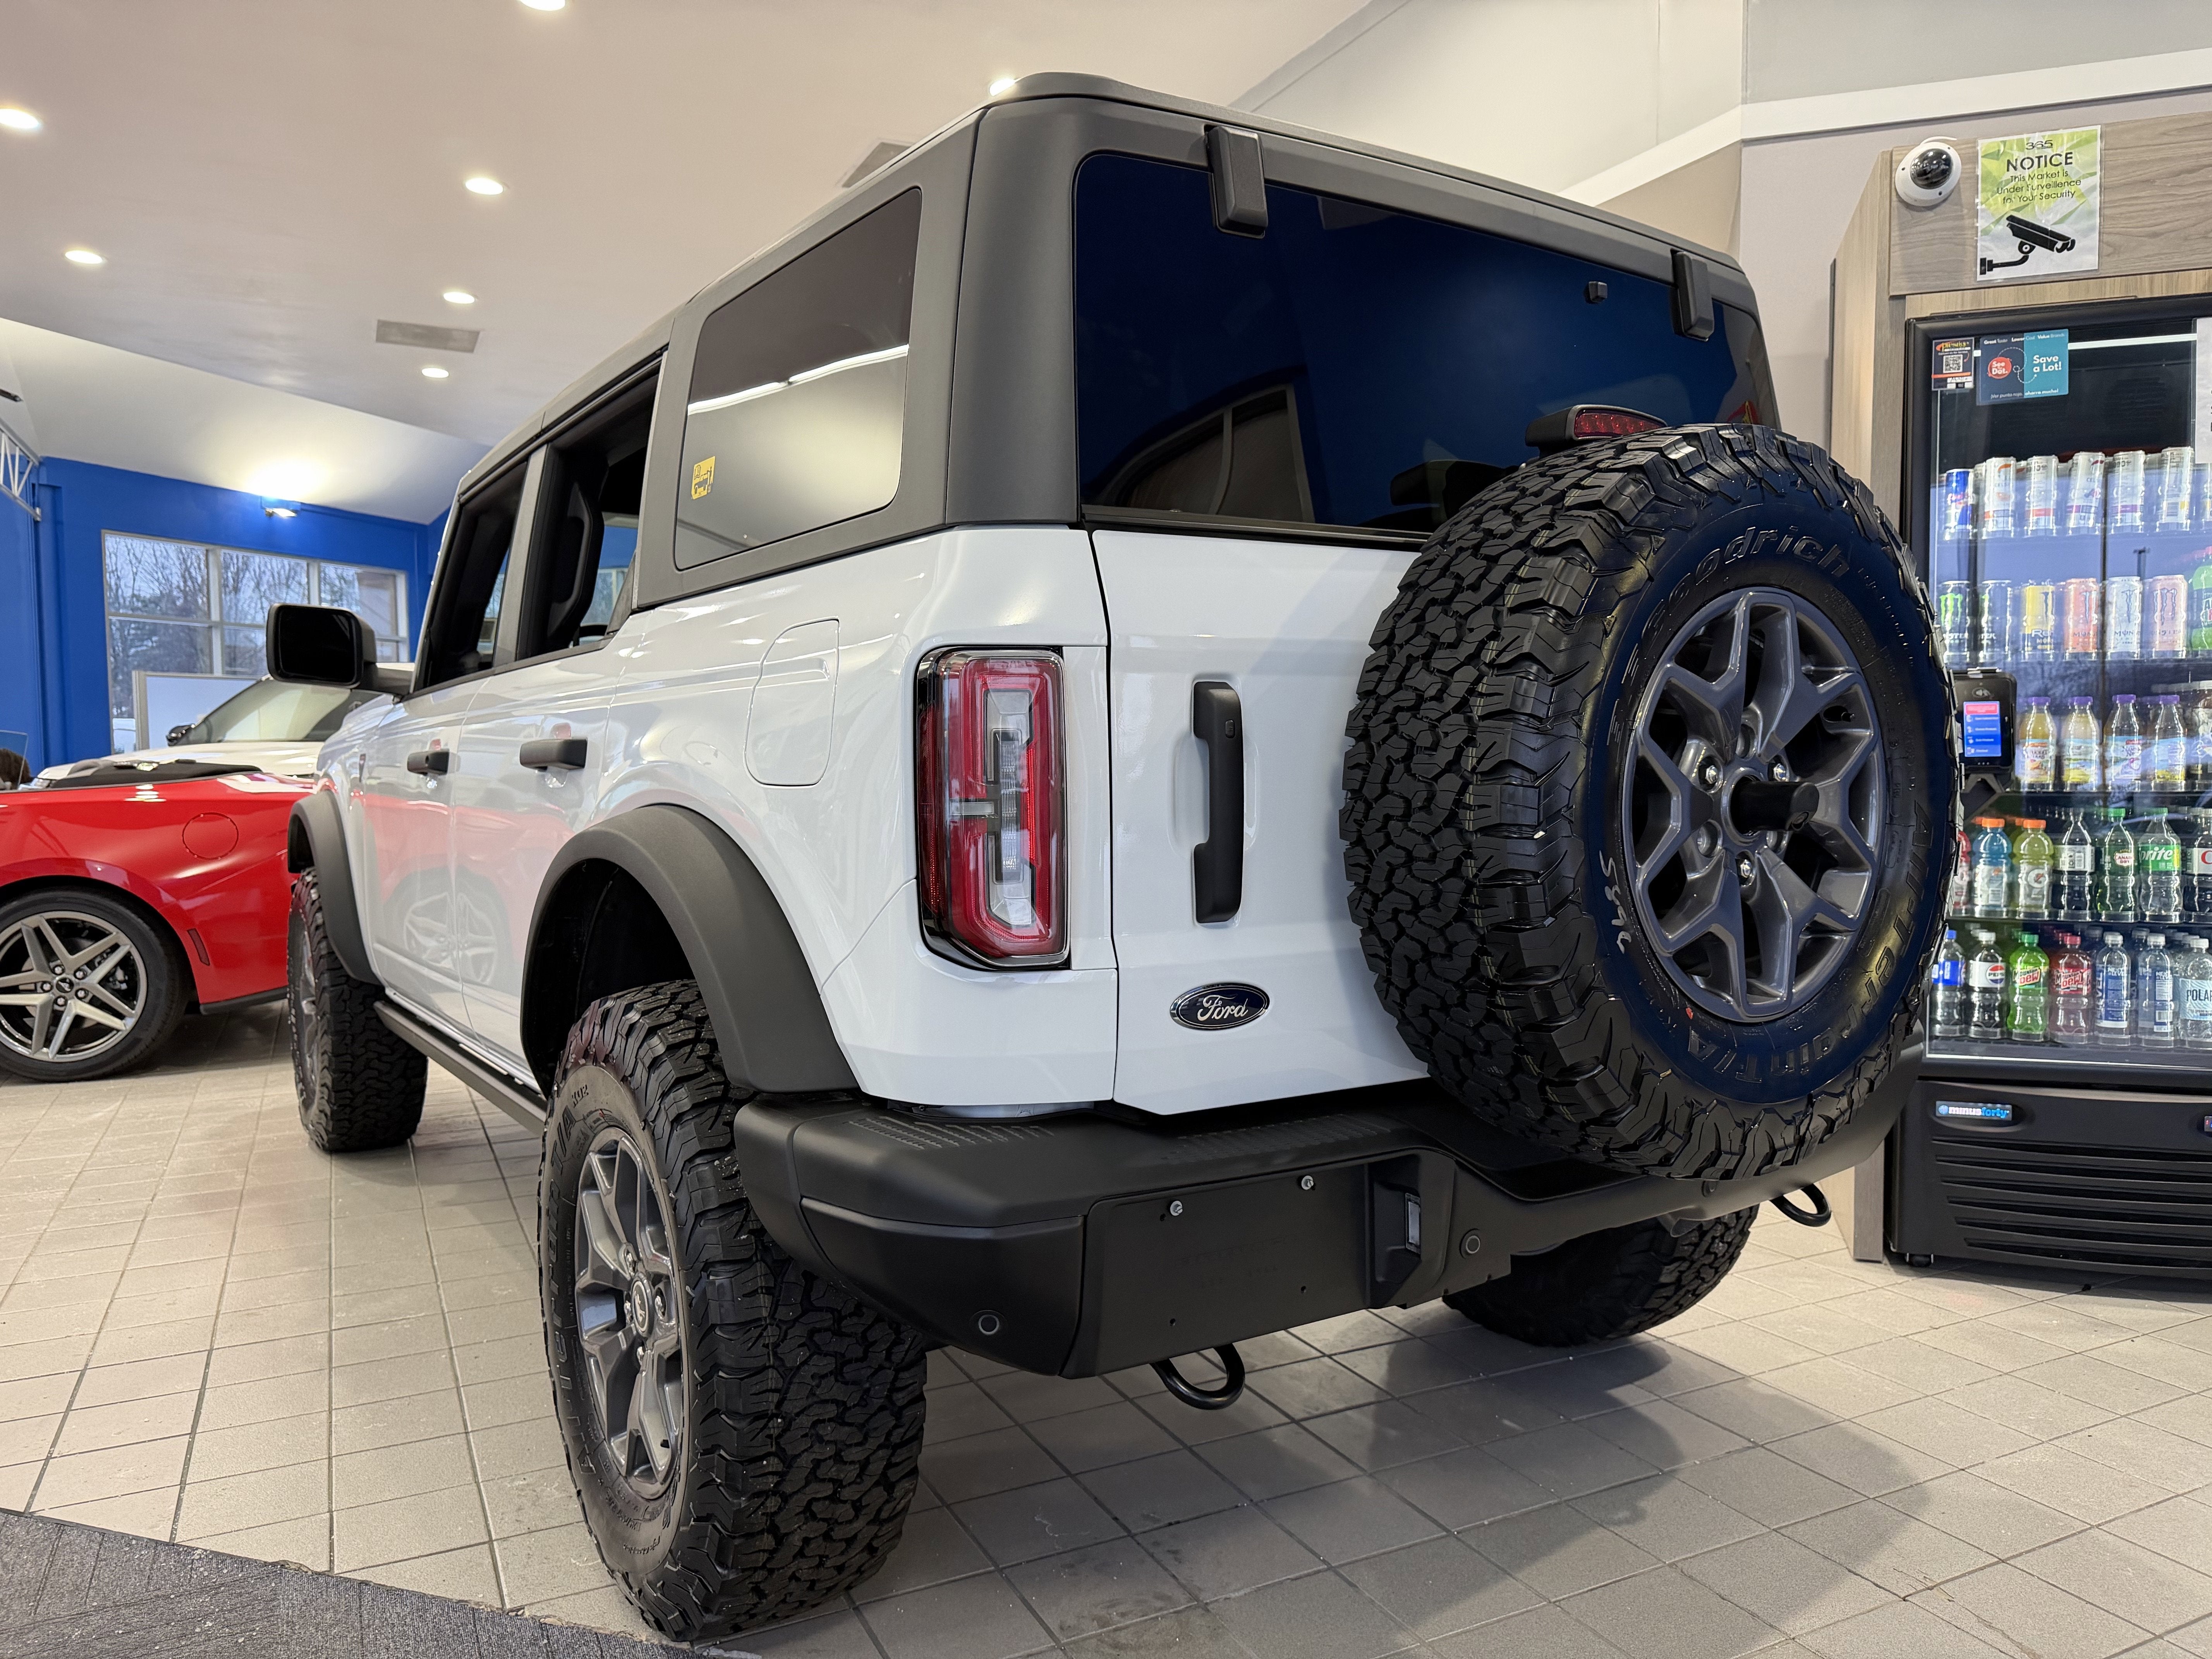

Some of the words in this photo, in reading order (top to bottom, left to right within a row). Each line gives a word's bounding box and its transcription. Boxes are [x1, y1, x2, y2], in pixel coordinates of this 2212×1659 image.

[2026, 140, 2053, 150] 365
[2006, 152, 2073, 172] NOTICE
[2010, 174, 2026, 183] This
[2028, 170, 2060, 181] Market
[1997, 185, 2025, 194] Under
[2017, 194, 2037, 203] Your
[2039, 190, 2076, 200] Security
[2033, 354, 2059, 364] Save
[2042, 361, 2062, 372] Lot!
[2139, 847, 2173, 861] prite
[1197, 994, 1248, 1021] Ford
